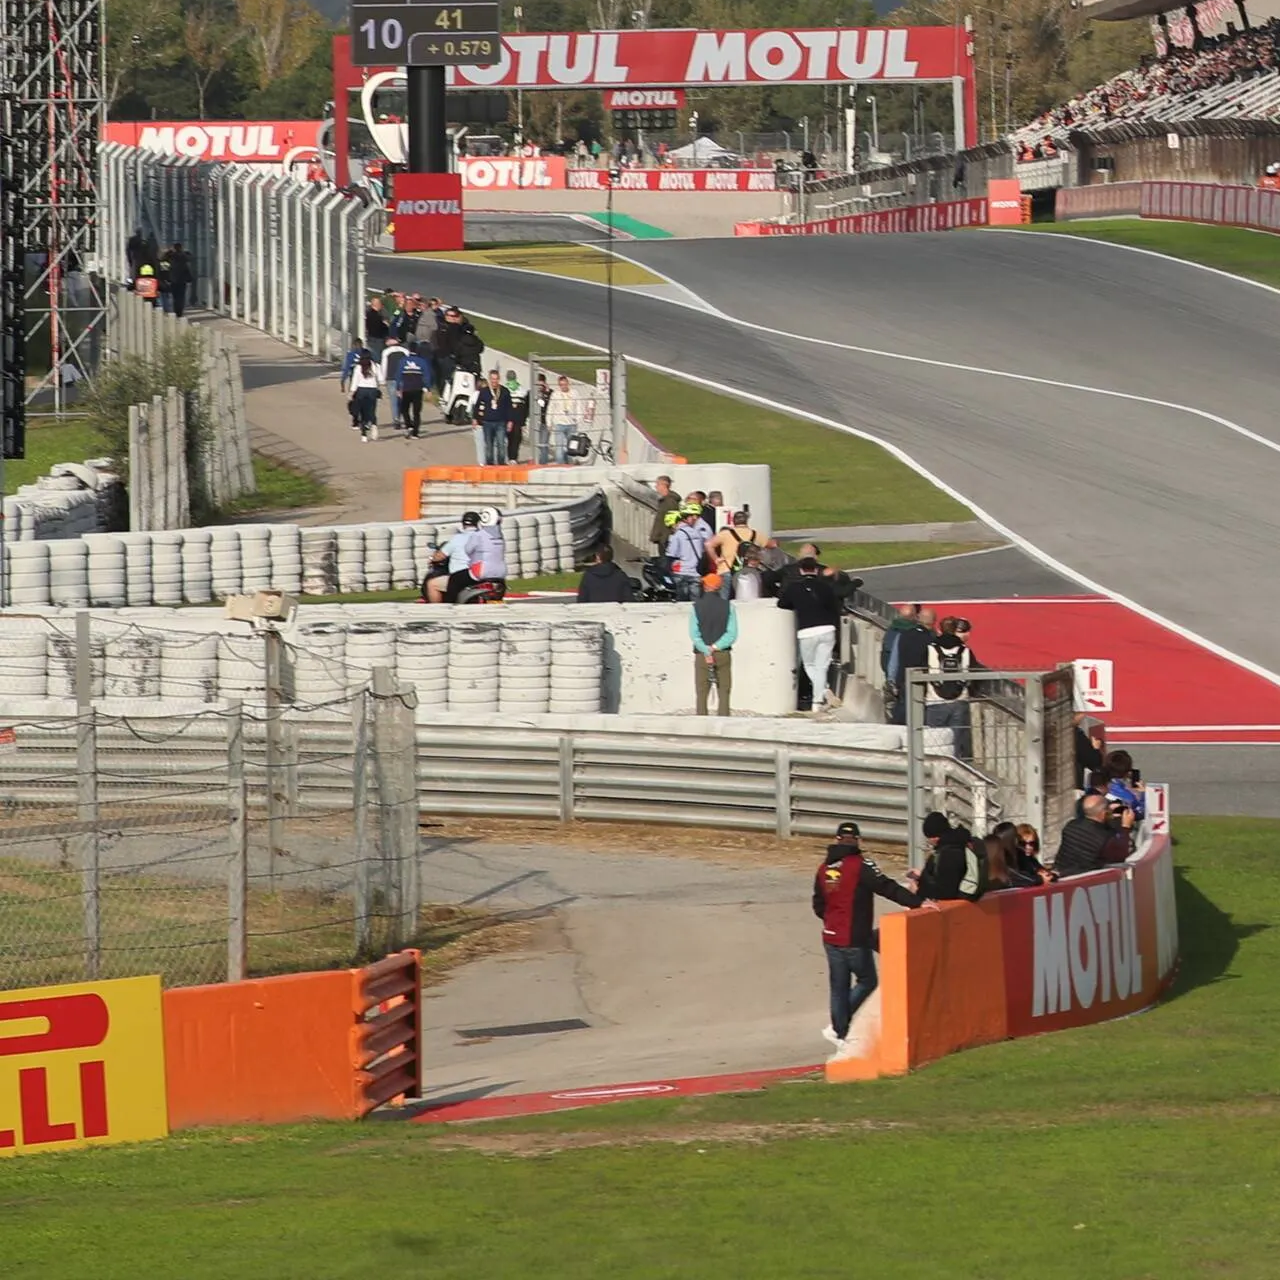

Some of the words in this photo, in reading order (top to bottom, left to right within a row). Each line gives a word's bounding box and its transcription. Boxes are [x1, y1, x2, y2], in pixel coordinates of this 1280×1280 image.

[359, 19, 403, 50] 10
[435, 9, 463, 30] 41
[684, 30, 919, 81] MOTUL
[610, 90, 678, 106] MOTUL
[138, 125, 279, 157] MOTUL
[396, 199, 461, 216] MOTUL
[1032, 879, 1142, 1017] MOTUL
